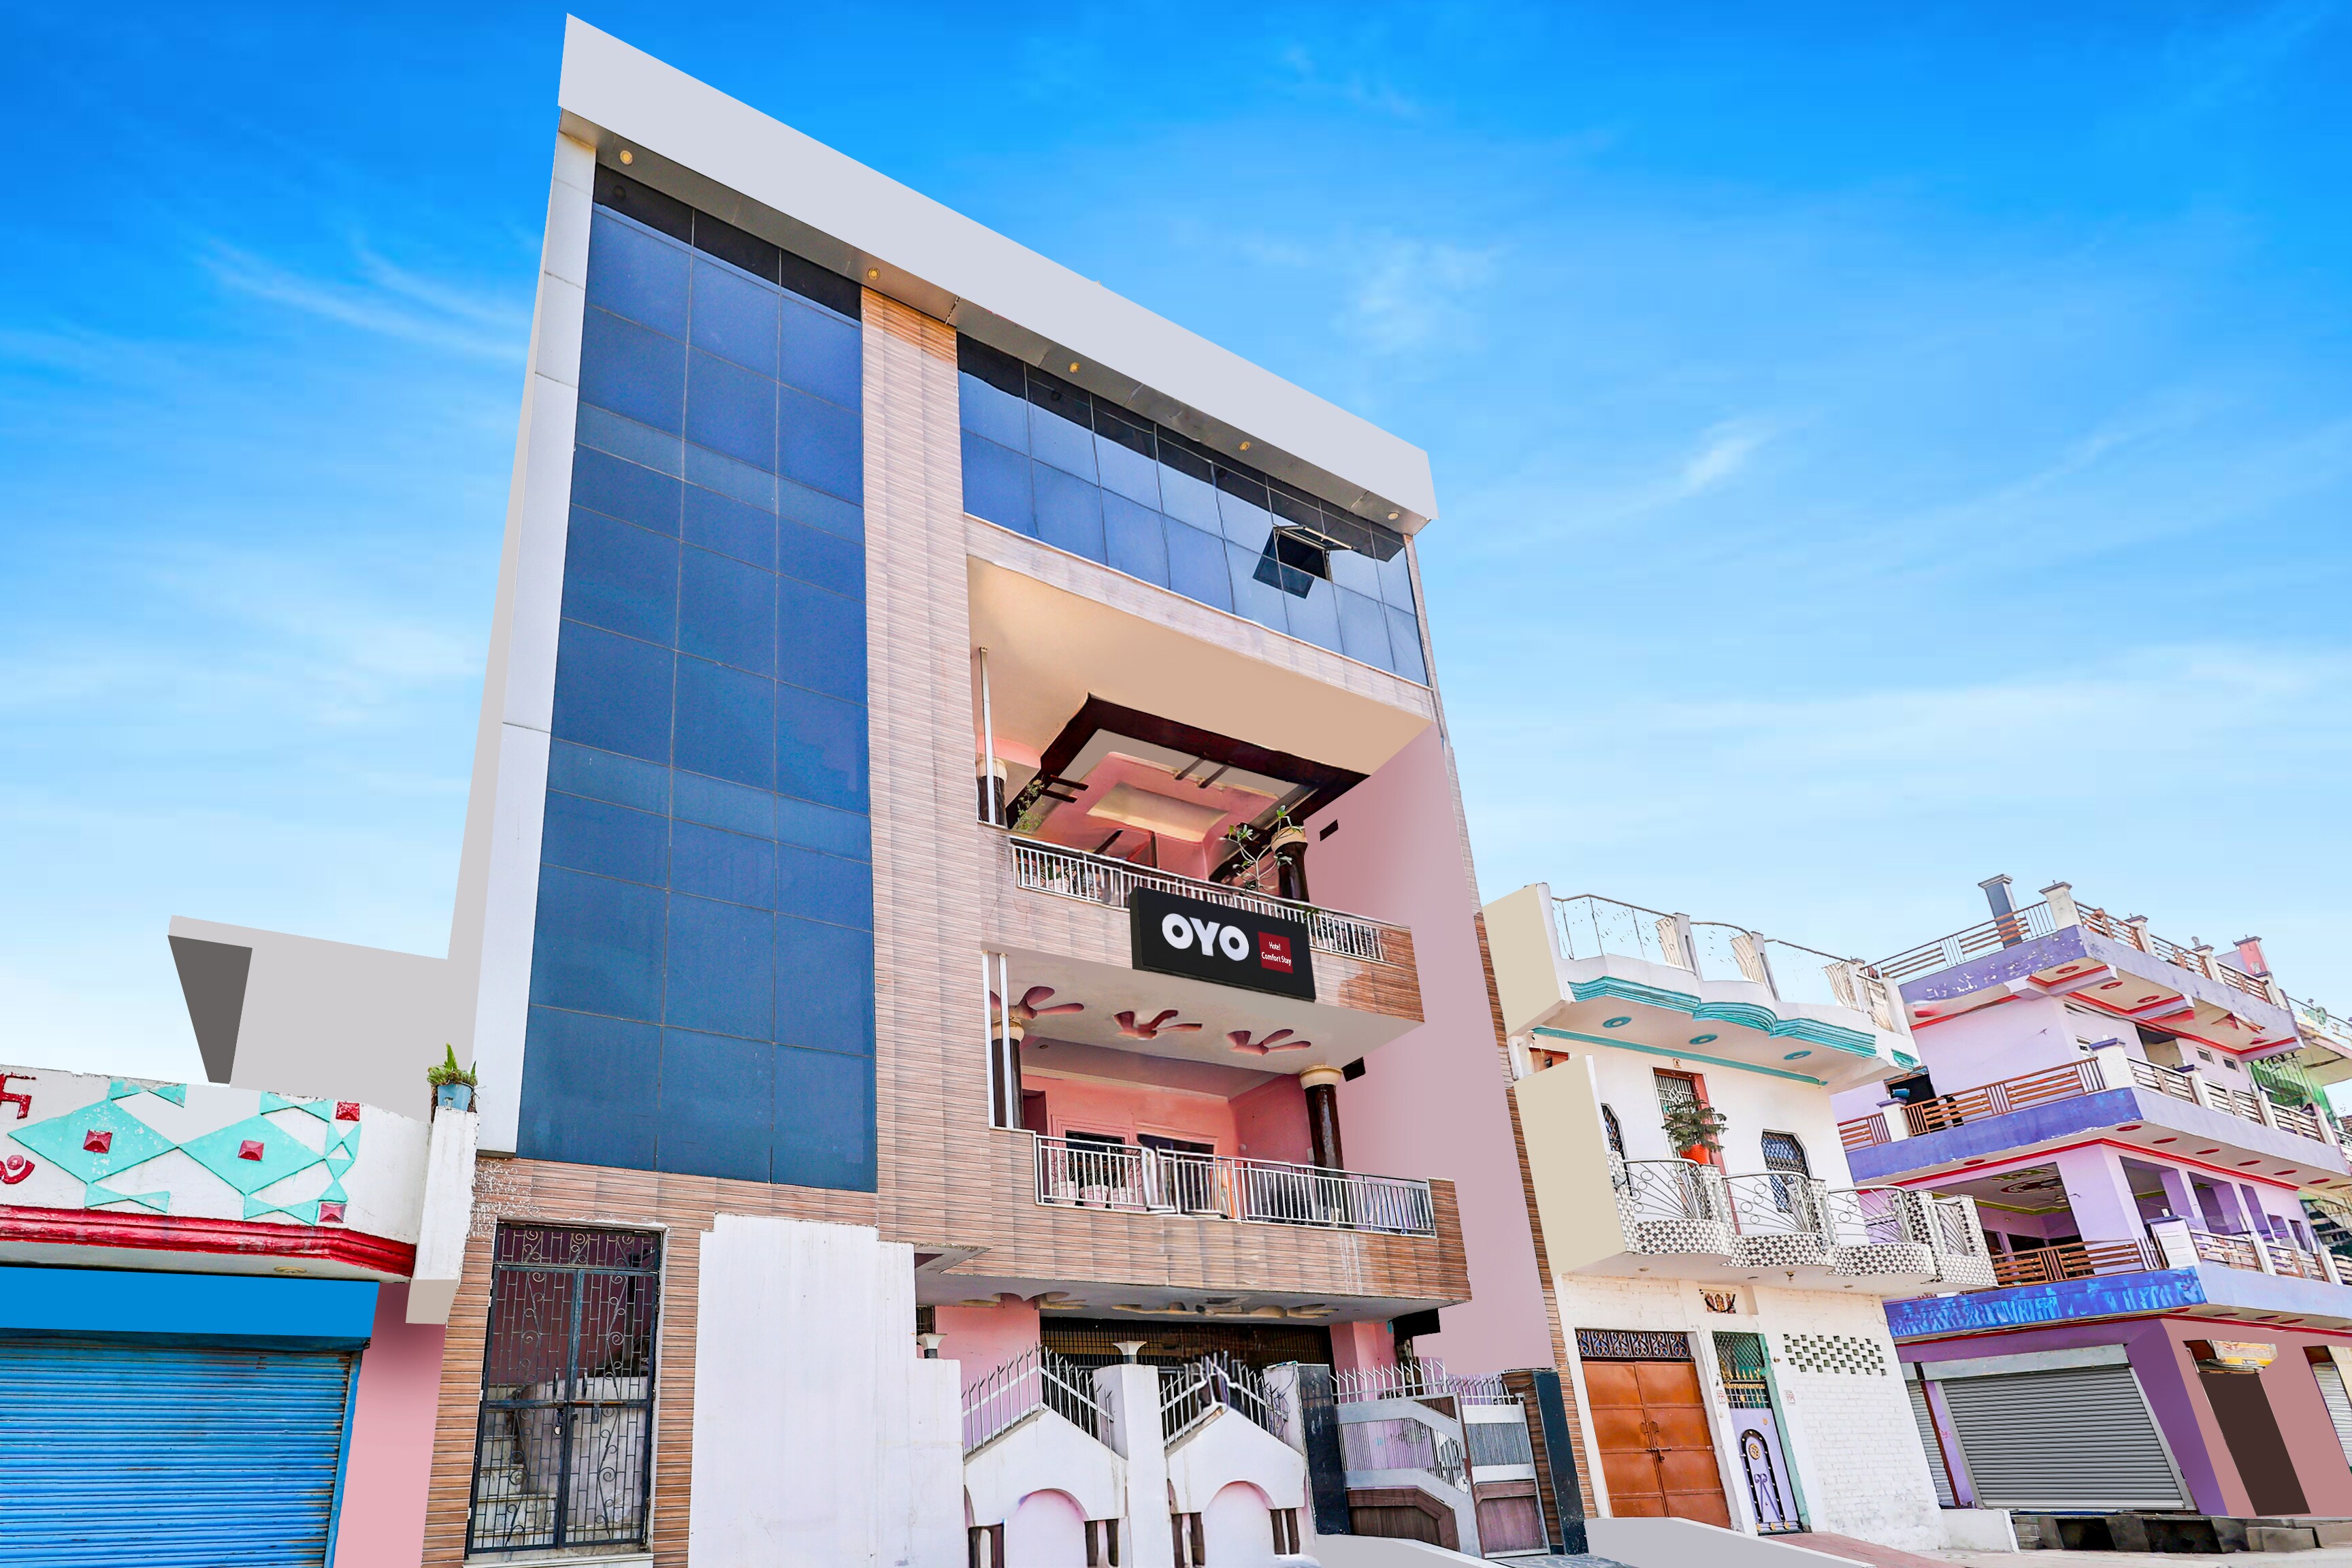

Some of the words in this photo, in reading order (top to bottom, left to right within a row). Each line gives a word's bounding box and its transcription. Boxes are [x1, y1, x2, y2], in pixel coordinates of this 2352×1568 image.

[1162, 913, 1250, 962] OYO
[1269, 941, 1281, 951] Hotel
[1261, 951, 1281, 962] Comfort
[1281, 956, 1292, 966] Stay
